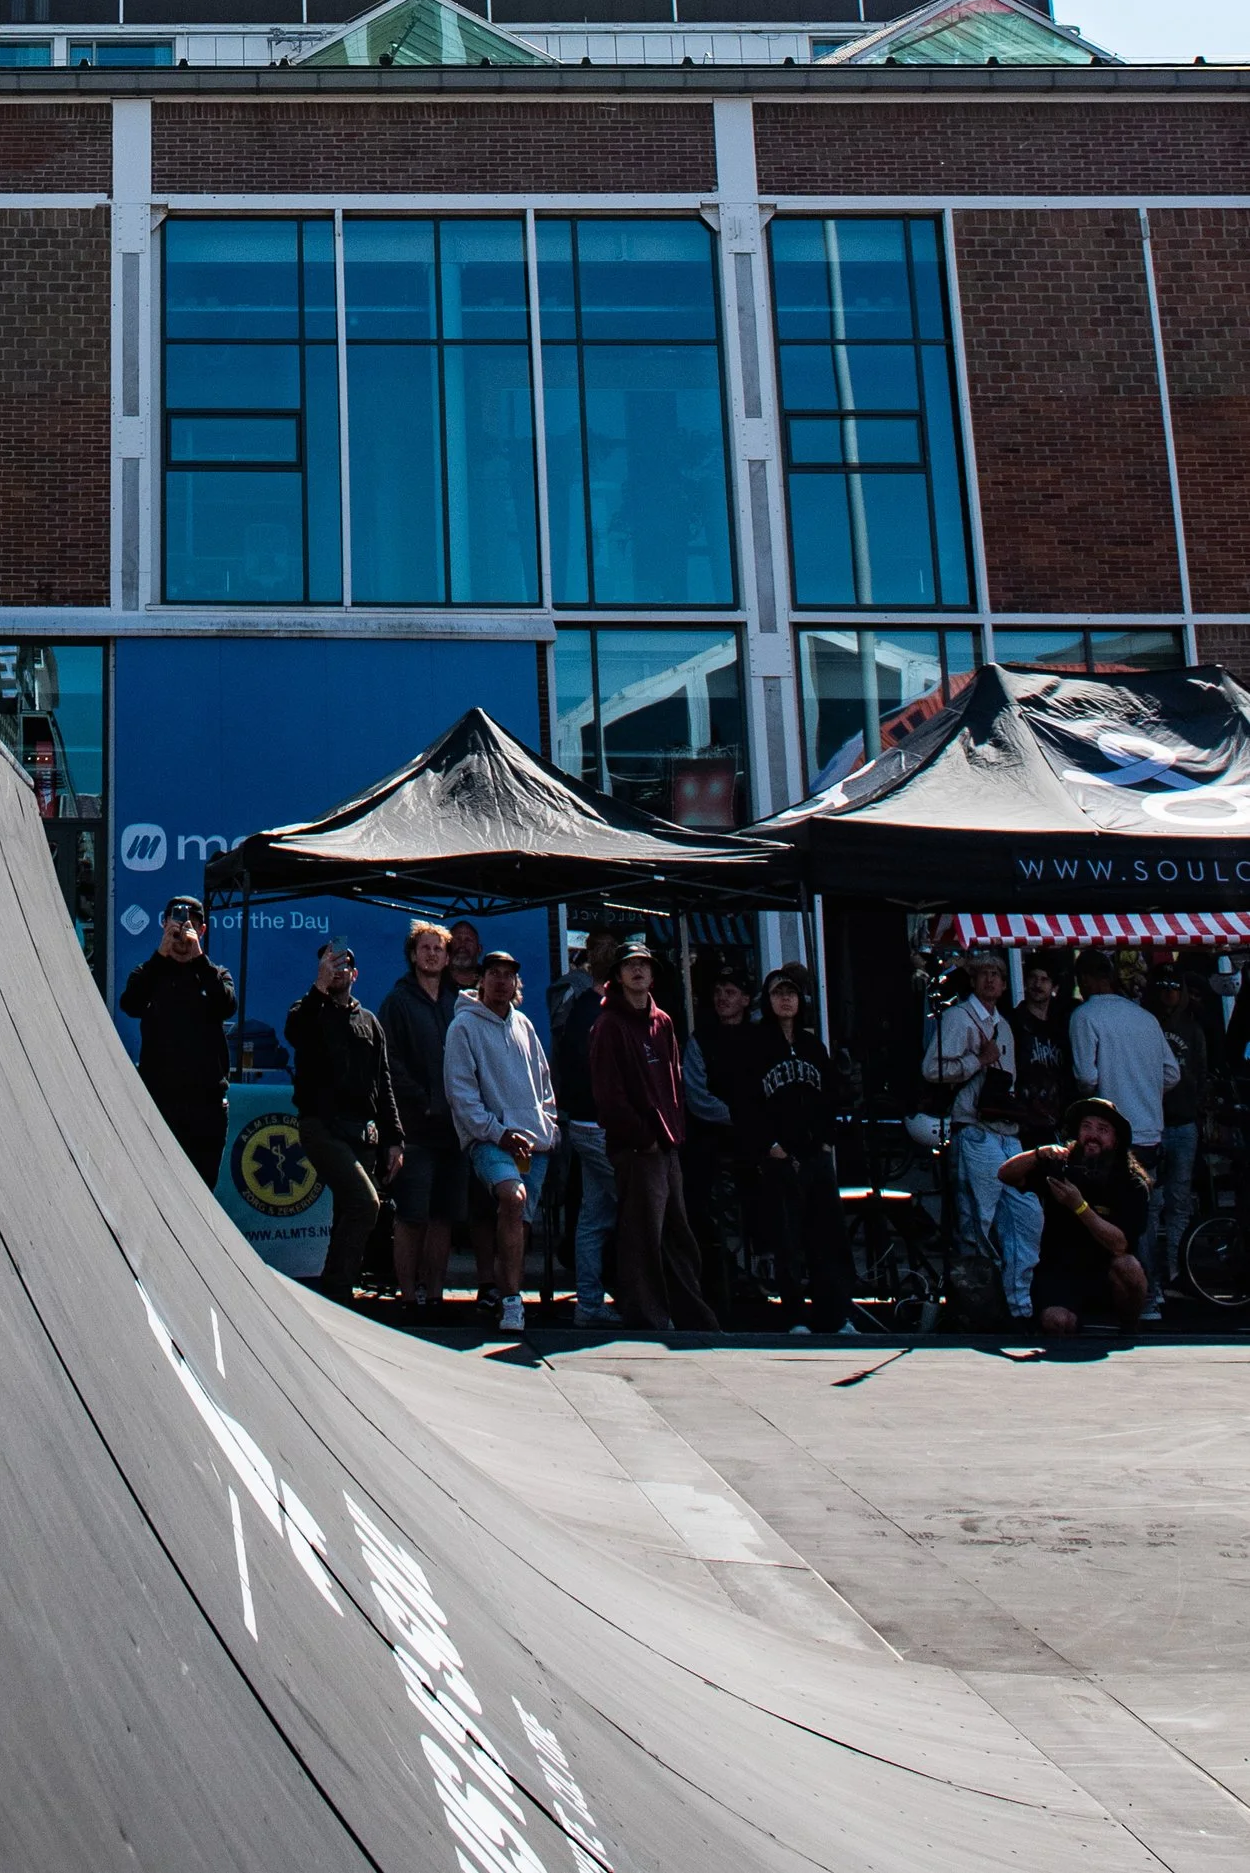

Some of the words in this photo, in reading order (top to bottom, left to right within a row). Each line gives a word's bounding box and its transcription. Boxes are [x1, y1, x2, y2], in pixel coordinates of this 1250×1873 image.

[222, 911, 244, 929] of
[250, 911, 285, 929] the
[289, 911, 329, 934] Day
